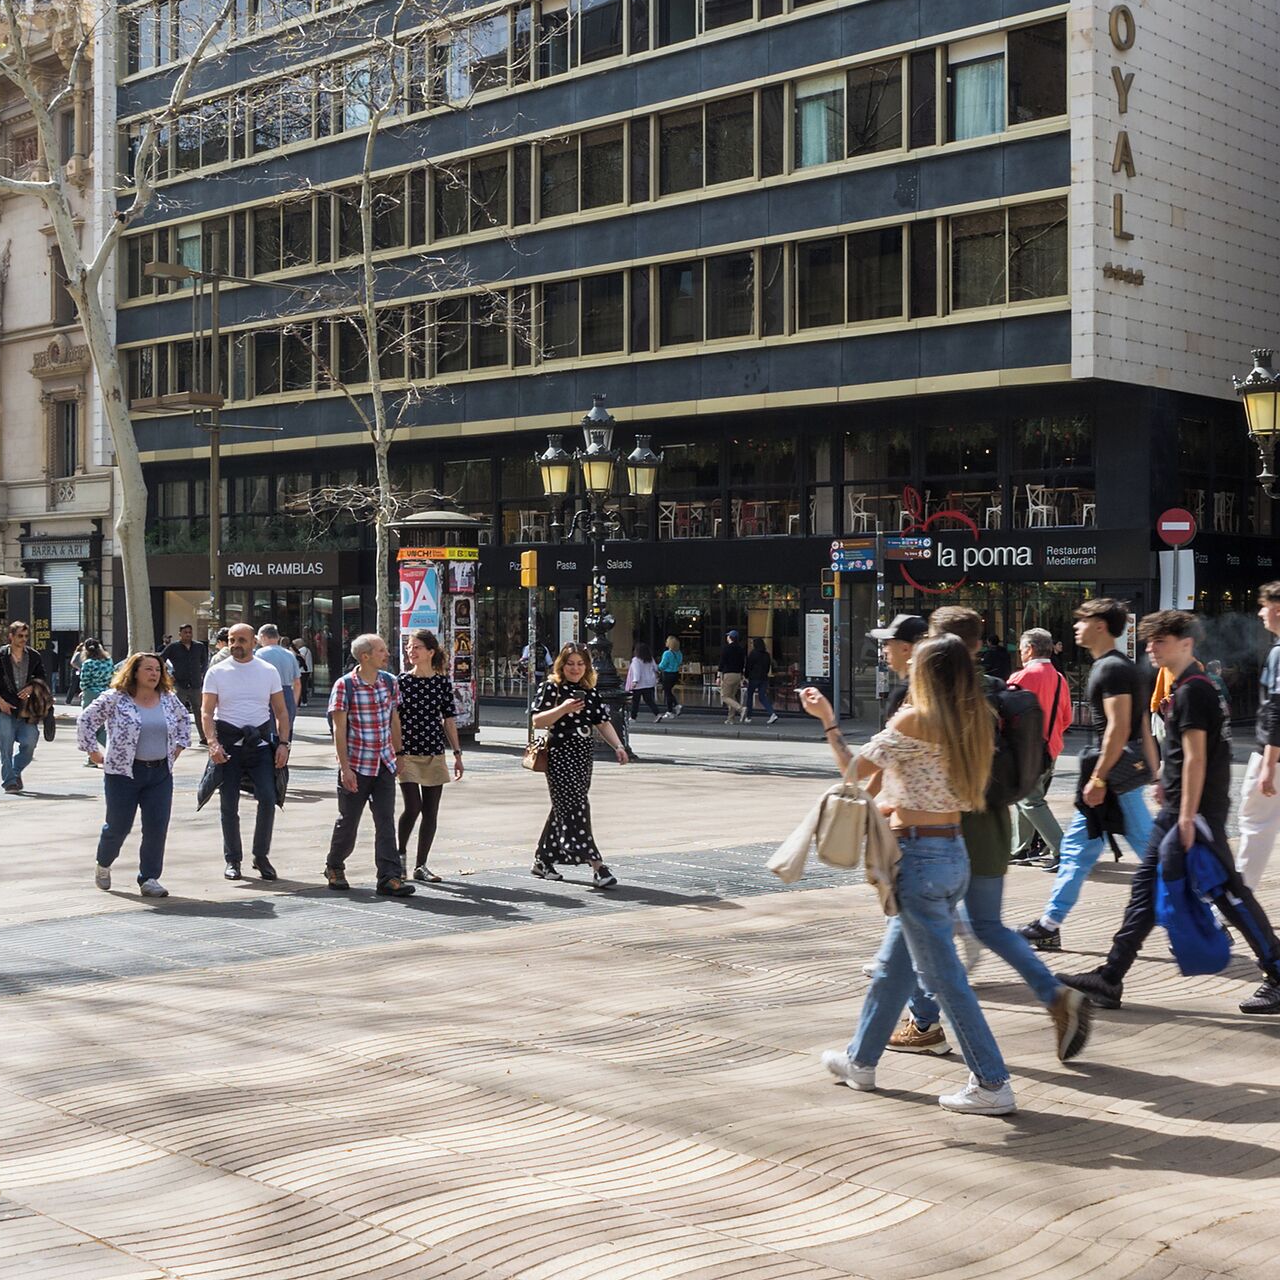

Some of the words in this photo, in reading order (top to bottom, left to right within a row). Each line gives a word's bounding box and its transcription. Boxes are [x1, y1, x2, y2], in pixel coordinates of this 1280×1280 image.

[31, 545, 58, 557] BARRA
[1046, 546, 1097, 556] Restaurant
[937, 542, 958, 567] la
[963, 546, 1034, 572] poma
[1046, 556, 1097, 566] Mediterrani
[227, 562, 263, 577] ROYAL
[267, 562, 324, 575] RAMBLAS
[556, 560, 577, 570] Pasta
[606, 559, 633, 570] Salads
